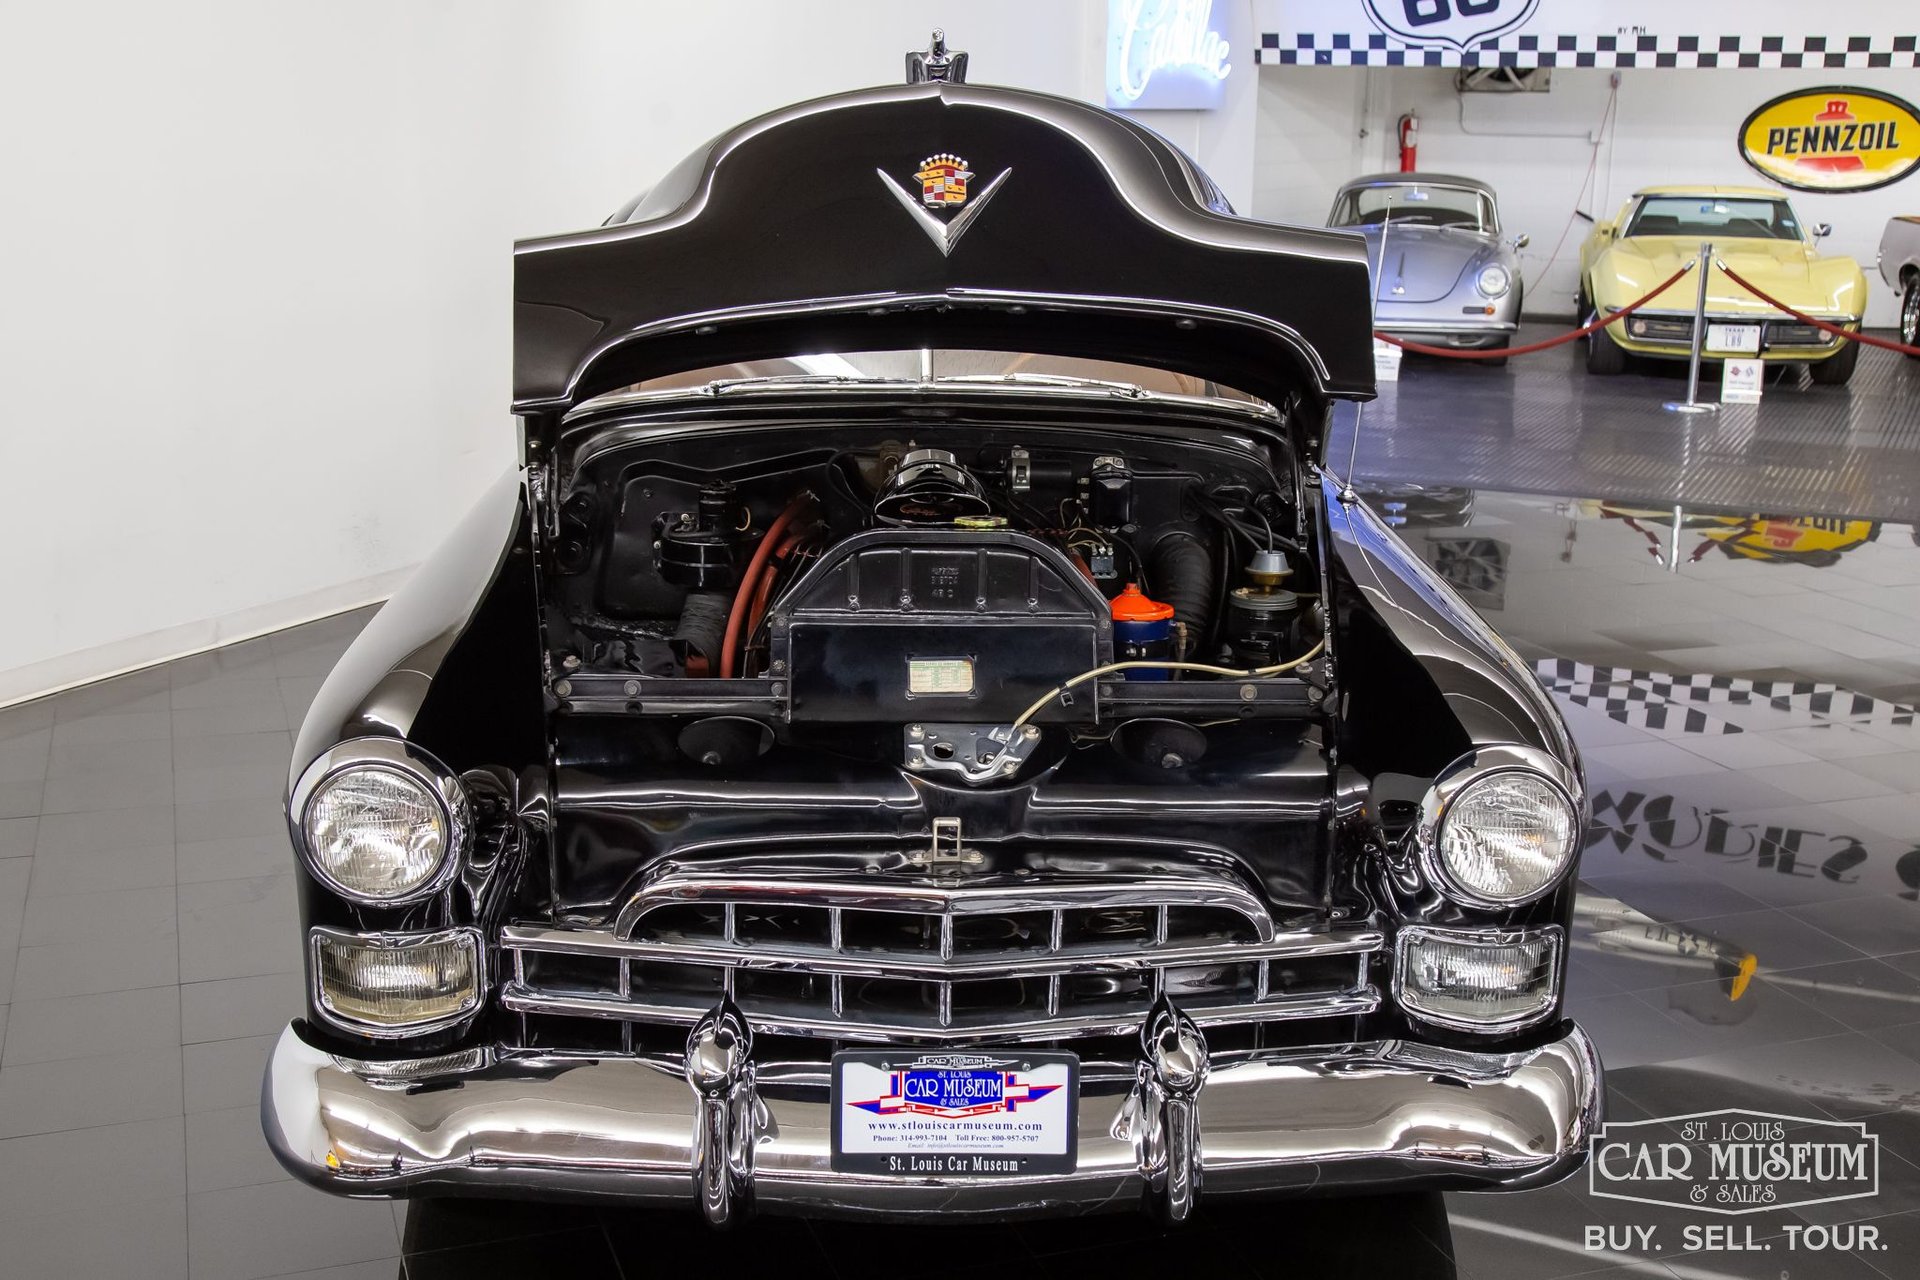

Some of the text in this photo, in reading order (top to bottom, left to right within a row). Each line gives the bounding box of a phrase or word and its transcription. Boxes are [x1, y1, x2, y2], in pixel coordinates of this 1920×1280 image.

[1766, 121, 1899, 155] PENNZOIL
[950, 1071, 972, 1079] LOUIS
[905, 1078, 1002, 1098] CAR MUSEUM
[949, 1098, 970, 1106] SALES
[868, 1120, 1043, 1131] www.stlouiscarmuseum.com
[991, 1134, 1039, 1143] 800-957-5707
[889, 1156, 1018, 1172] St. Louis Car Museum
